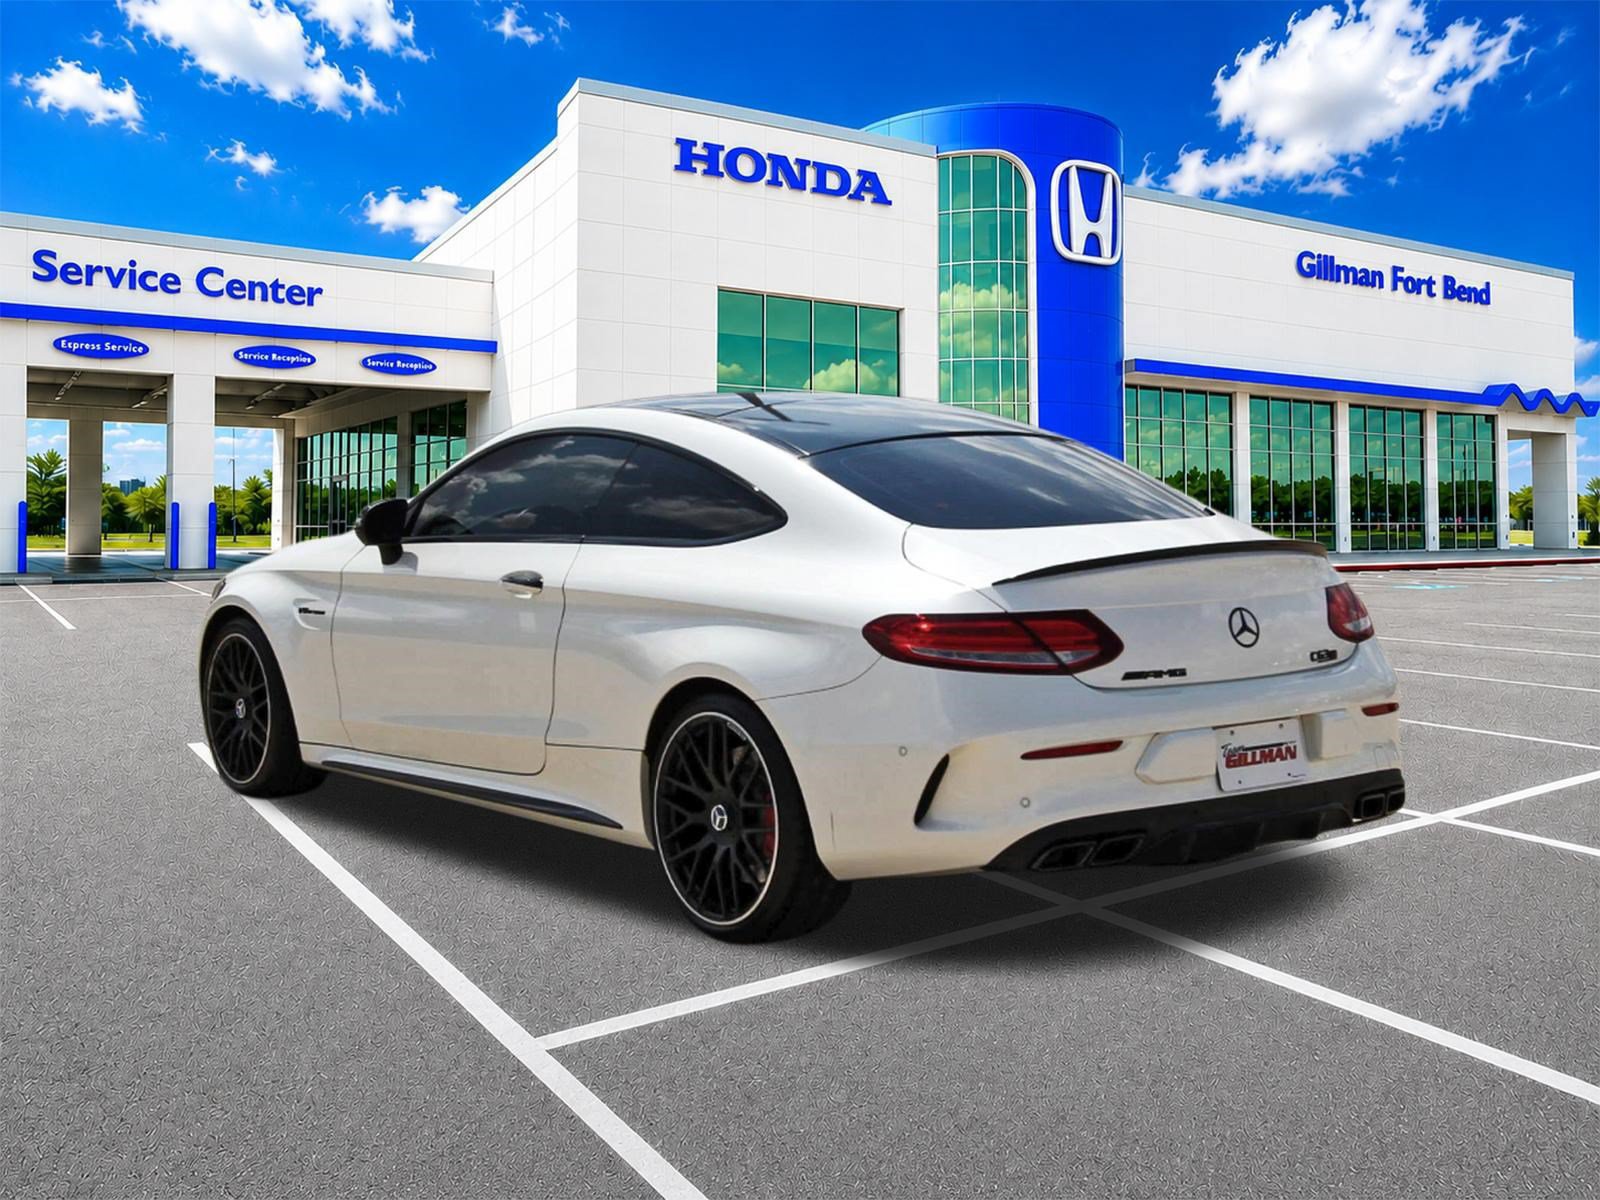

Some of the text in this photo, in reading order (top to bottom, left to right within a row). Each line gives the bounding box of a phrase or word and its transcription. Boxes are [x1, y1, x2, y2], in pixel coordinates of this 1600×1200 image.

[673, 137, 892, 206] HONDA
[31, 249, 323, 307] Service Center
[1296, 250, 1491, 305] Gillman Fort Bend
[60, 339, 144, 353] Express Service
[238, 351, 269, 361] Service
[367, 358, 395, 368] Service
[1225, 744, 1297, 769] GILLMAN
